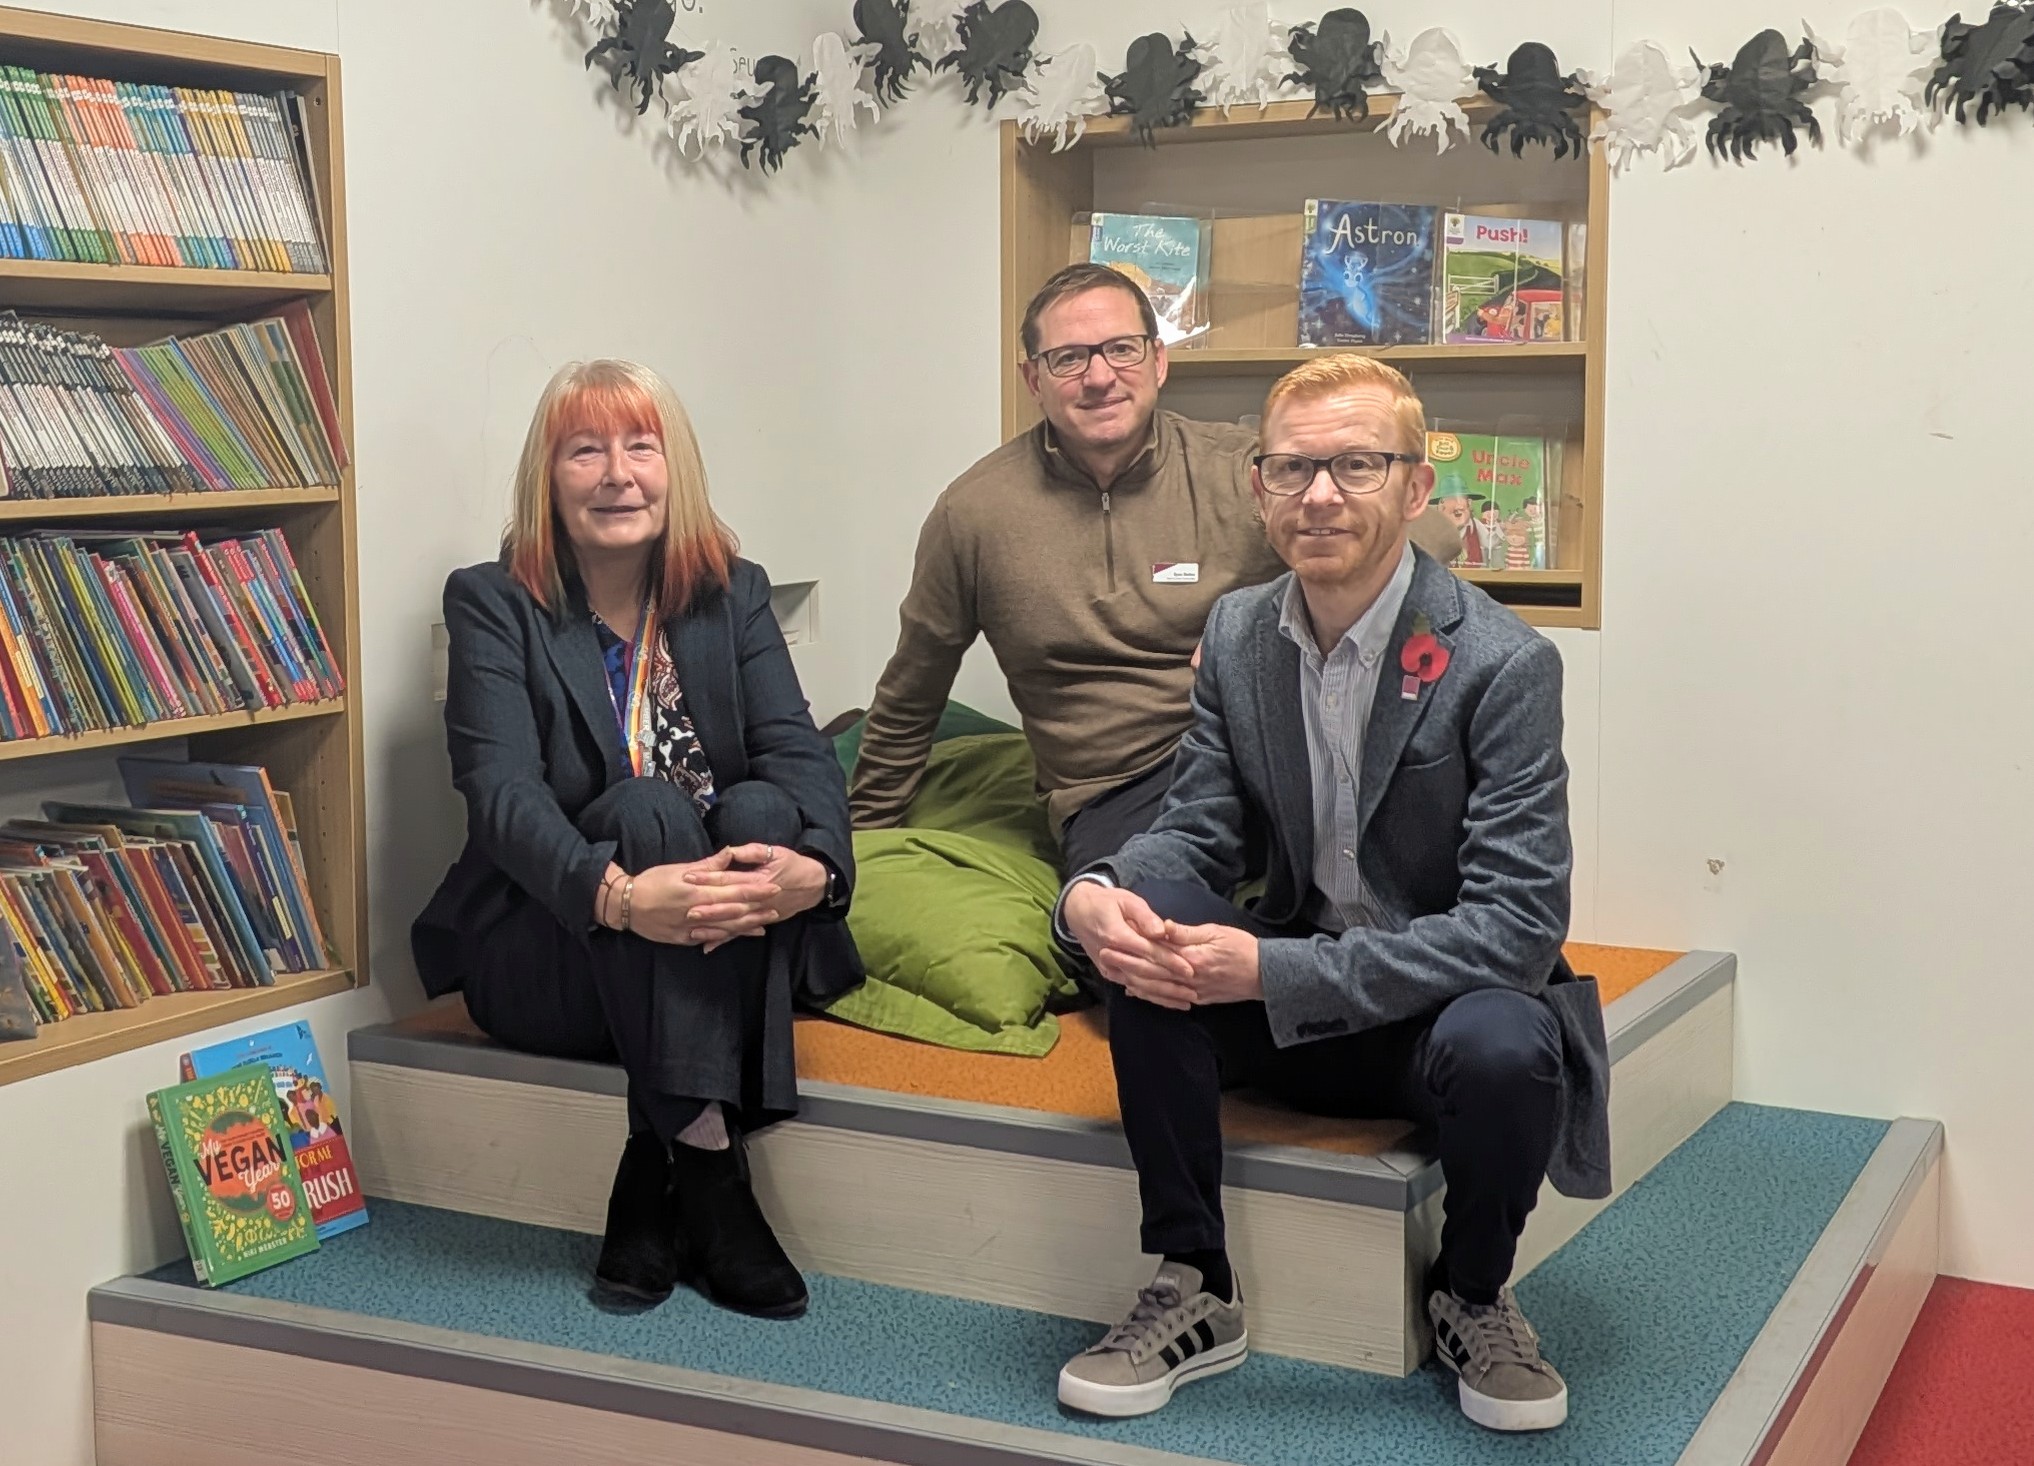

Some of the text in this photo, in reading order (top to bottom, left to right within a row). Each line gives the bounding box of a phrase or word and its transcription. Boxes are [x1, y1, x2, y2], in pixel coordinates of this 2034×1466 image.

[1133, 223, 1165, 239] The
[1325, 213, 1420, 255] Astron
[1476, 225, 1529, 244] Push!
[1104, 236, 1191, 257] Worst Kite
[1473, 451, 1530, 470] Uncle
[1477, 468, 1522, 486] Max
[200, 1138, 223, 1159] My
[313, 1144, 332, 1166] ME
[160, 1140, 181, 1188] VEGAN
[193, 1133, 286, 1187] VEGAN
[237, 1160, 281, 1194] Year
[303, 1167, 354, 1210] RUSH
[271, 1190, 291, 1209] 50
